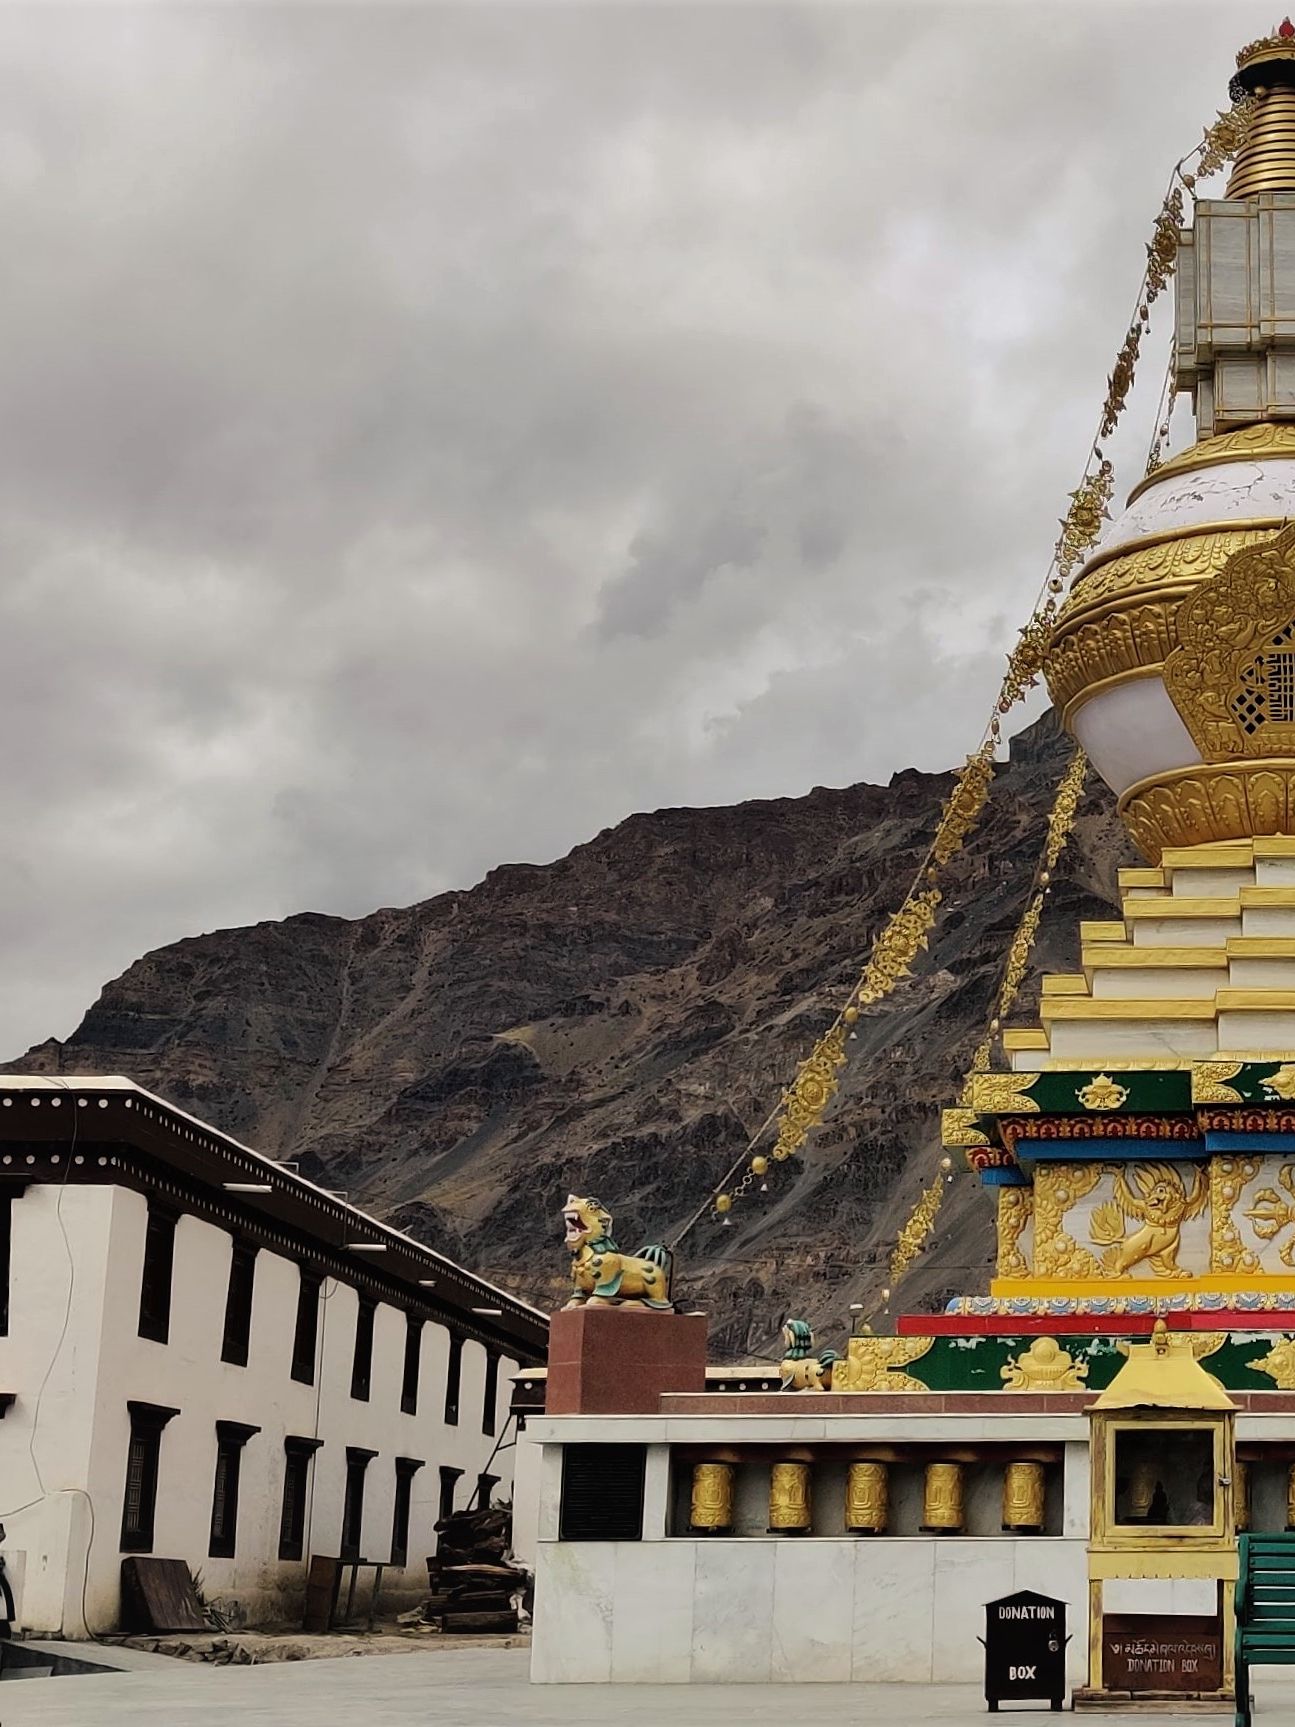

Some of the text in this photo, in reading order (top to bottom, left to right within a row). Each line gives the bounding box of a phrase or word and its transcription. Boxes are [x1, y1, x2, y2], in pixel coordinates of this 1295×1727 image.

[998, 1605, 1055, 1620] DONATION
[1008, 1665, 1037, 1681] BOX
[1127, 1658, 1199, 1673] DONATION BOX
